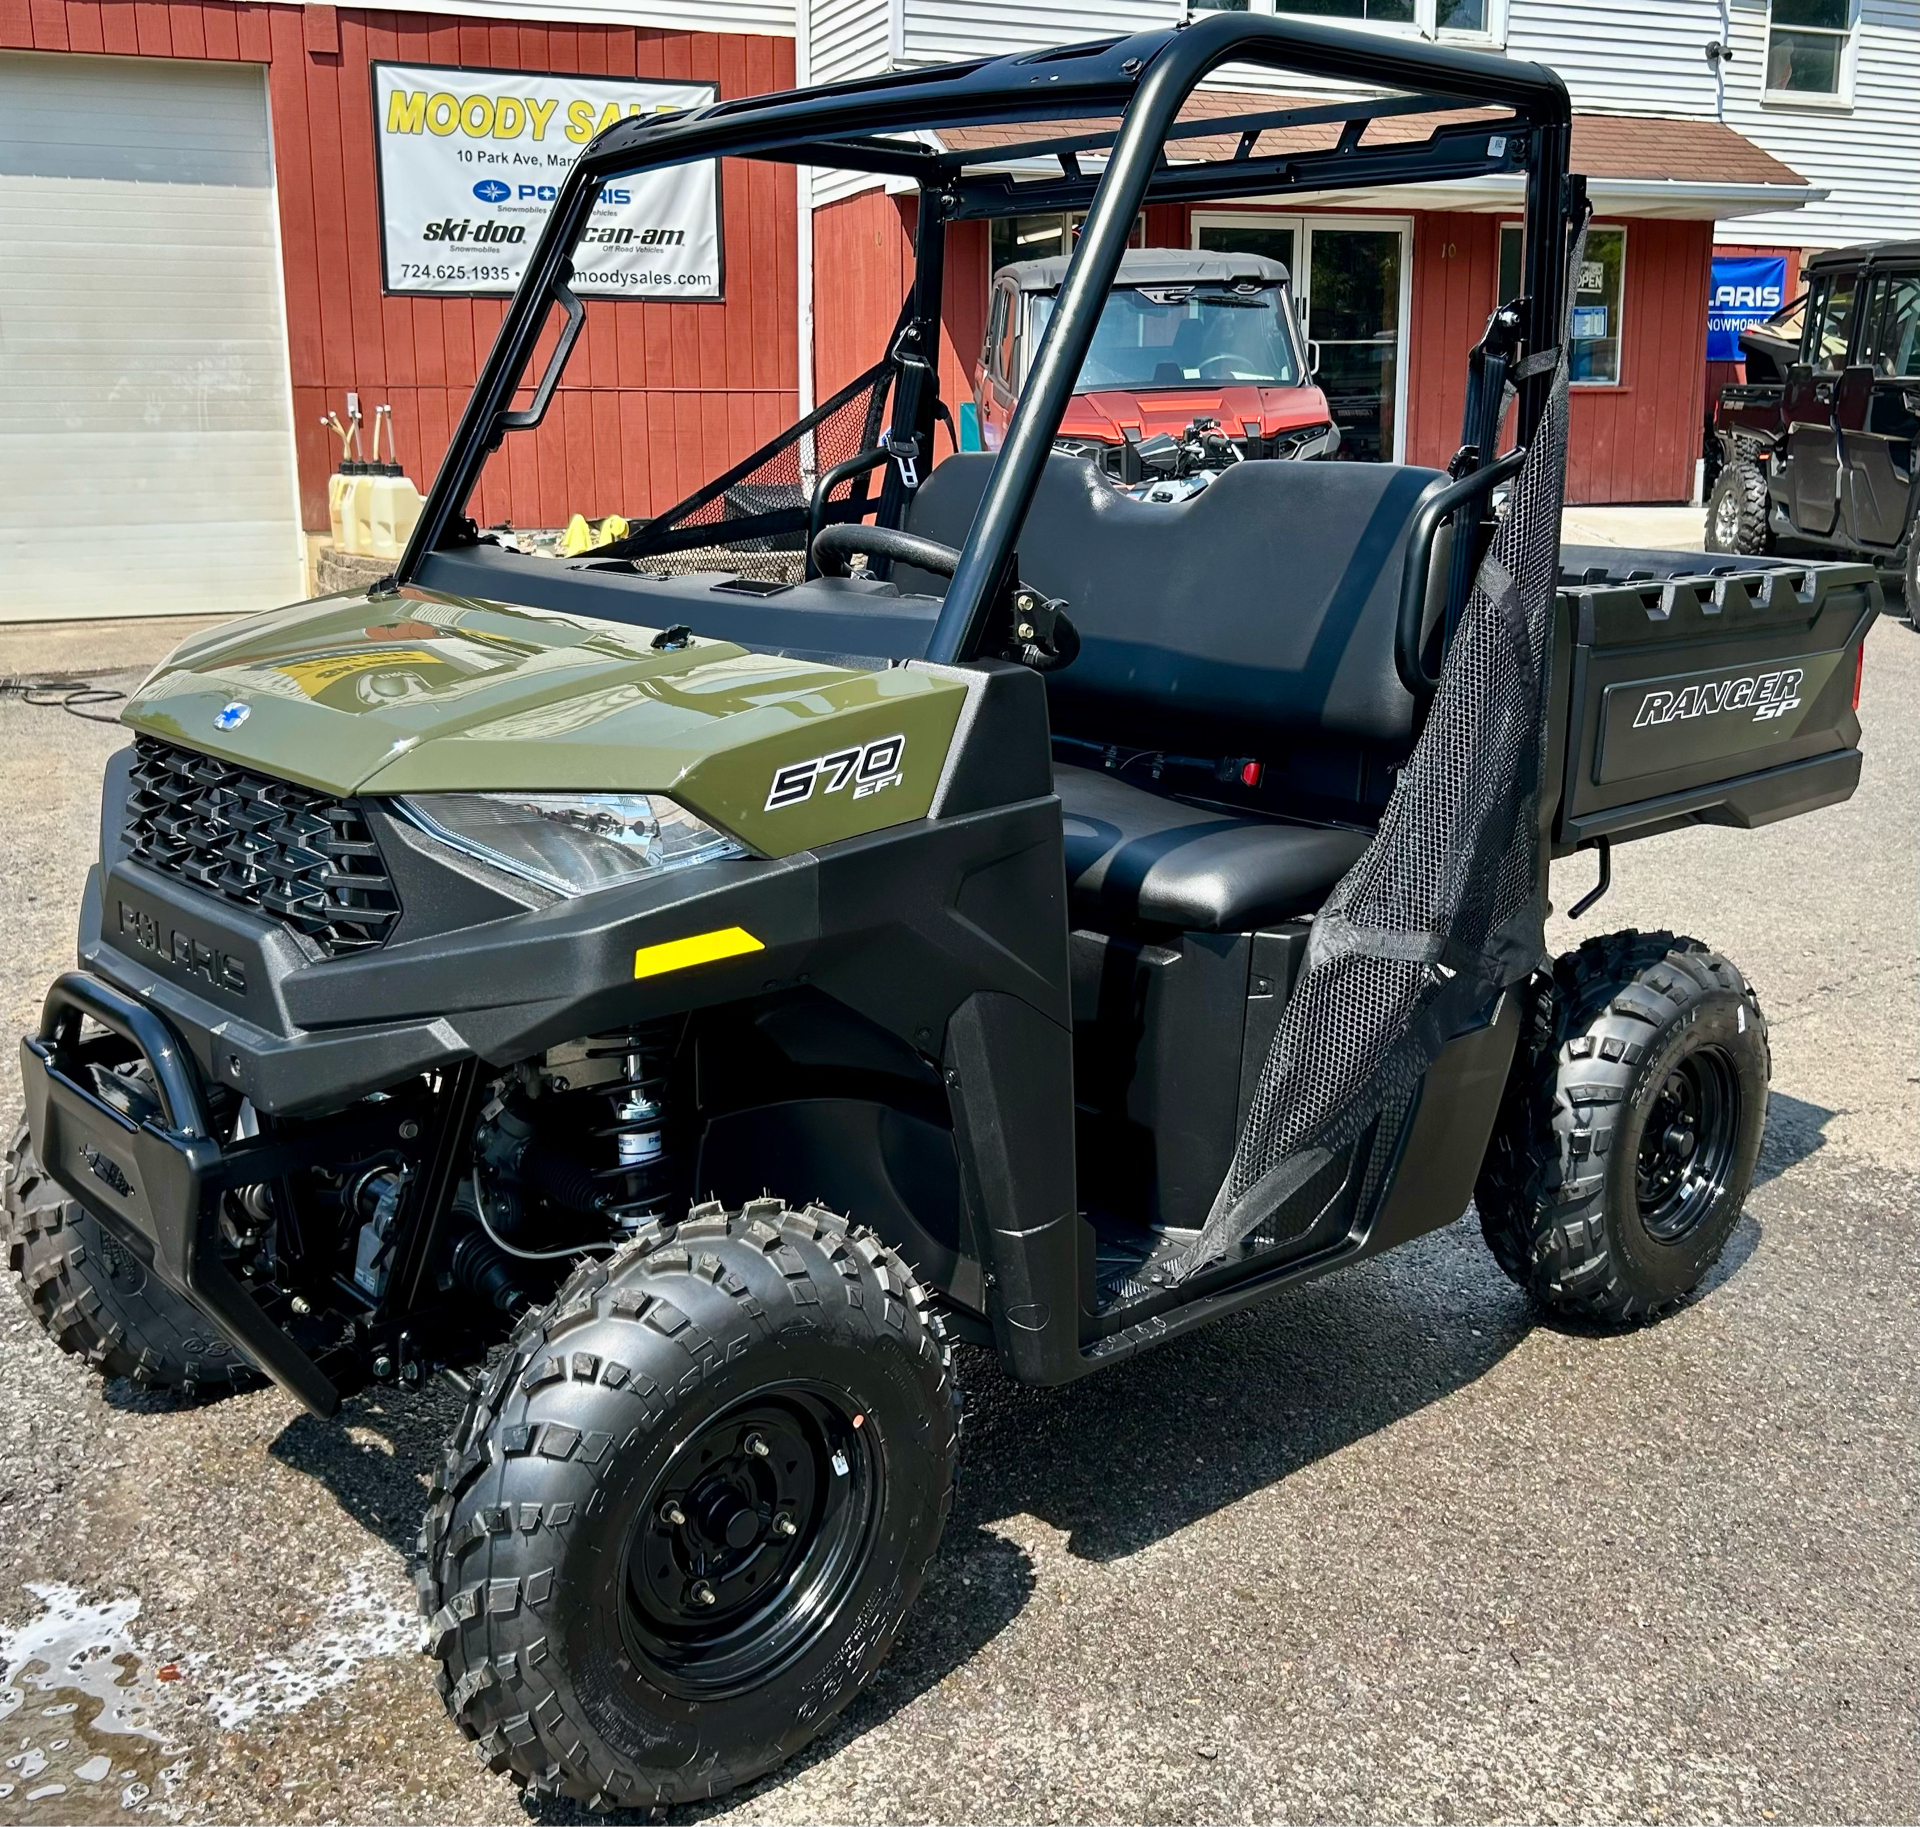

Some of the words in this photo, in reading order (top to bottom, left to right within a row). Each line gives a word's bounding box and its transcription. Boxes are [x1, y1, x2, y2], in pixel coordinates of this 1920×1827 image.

[386, 89, 559, 141] MOODY
[457, 150, 473, 162] 10
[477, 151, 509, 164] Park
[512, 153, 543, 167] Ave,
[497, 205, 547, 214] Snowmobiles
[423, 218, 526, 244] ski-doo
[450, 245, 501, 254] Snowmobiles
[635, 246, 664, 254] Vehicles
[1442, 243, 1456, 258] 10
[401, 264, 510, 280] 724.625.1935
[1633, 668, 1803, 728] RANGER
[1752, 698, 1801, 722] SP
[763, 734, 905, 812] 570
[853, 773, 903, 800] EFI
[118, 900, 247, 998] POLARIS
